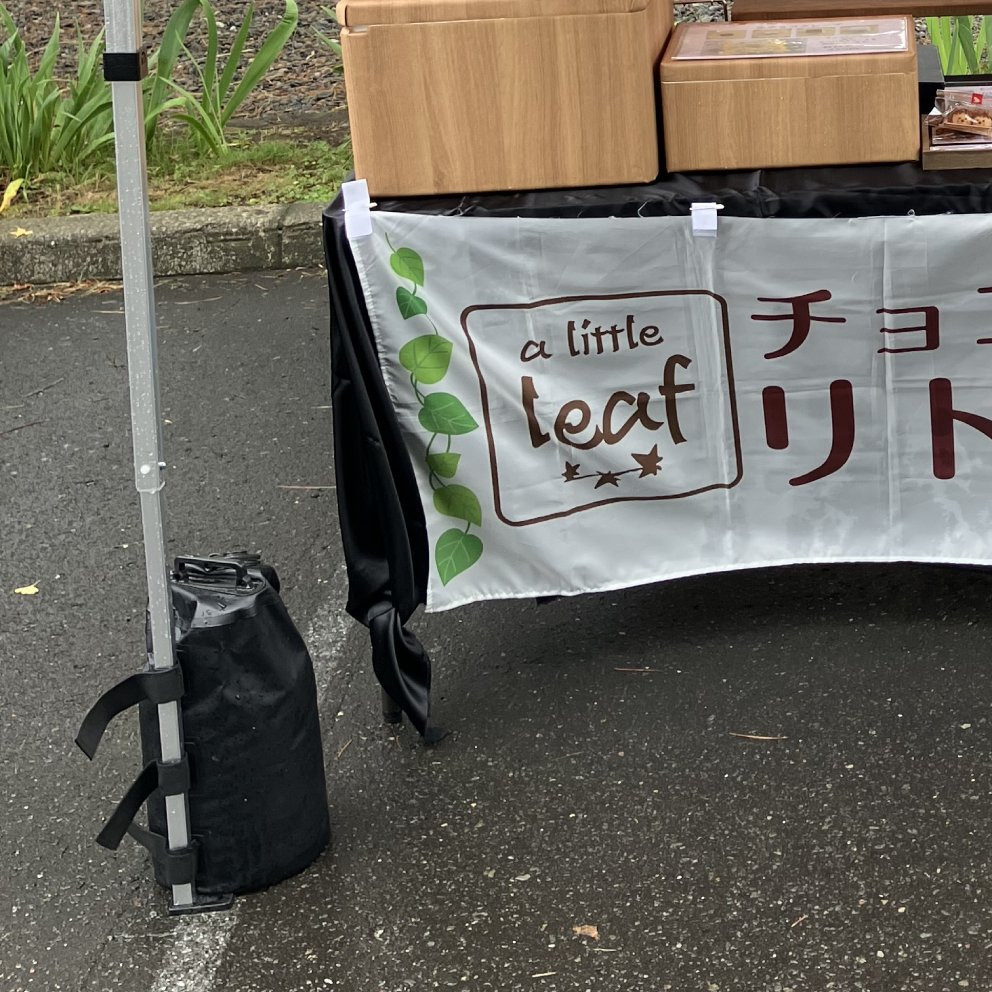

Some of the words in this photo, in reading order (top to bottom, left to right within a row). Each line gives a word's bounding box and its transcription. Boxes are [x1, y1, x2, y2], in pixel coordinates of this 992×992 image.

[521, 337, 552, 362] a
[566, 314, 664, 358] little
[521, 354, 696, 450] leaf
